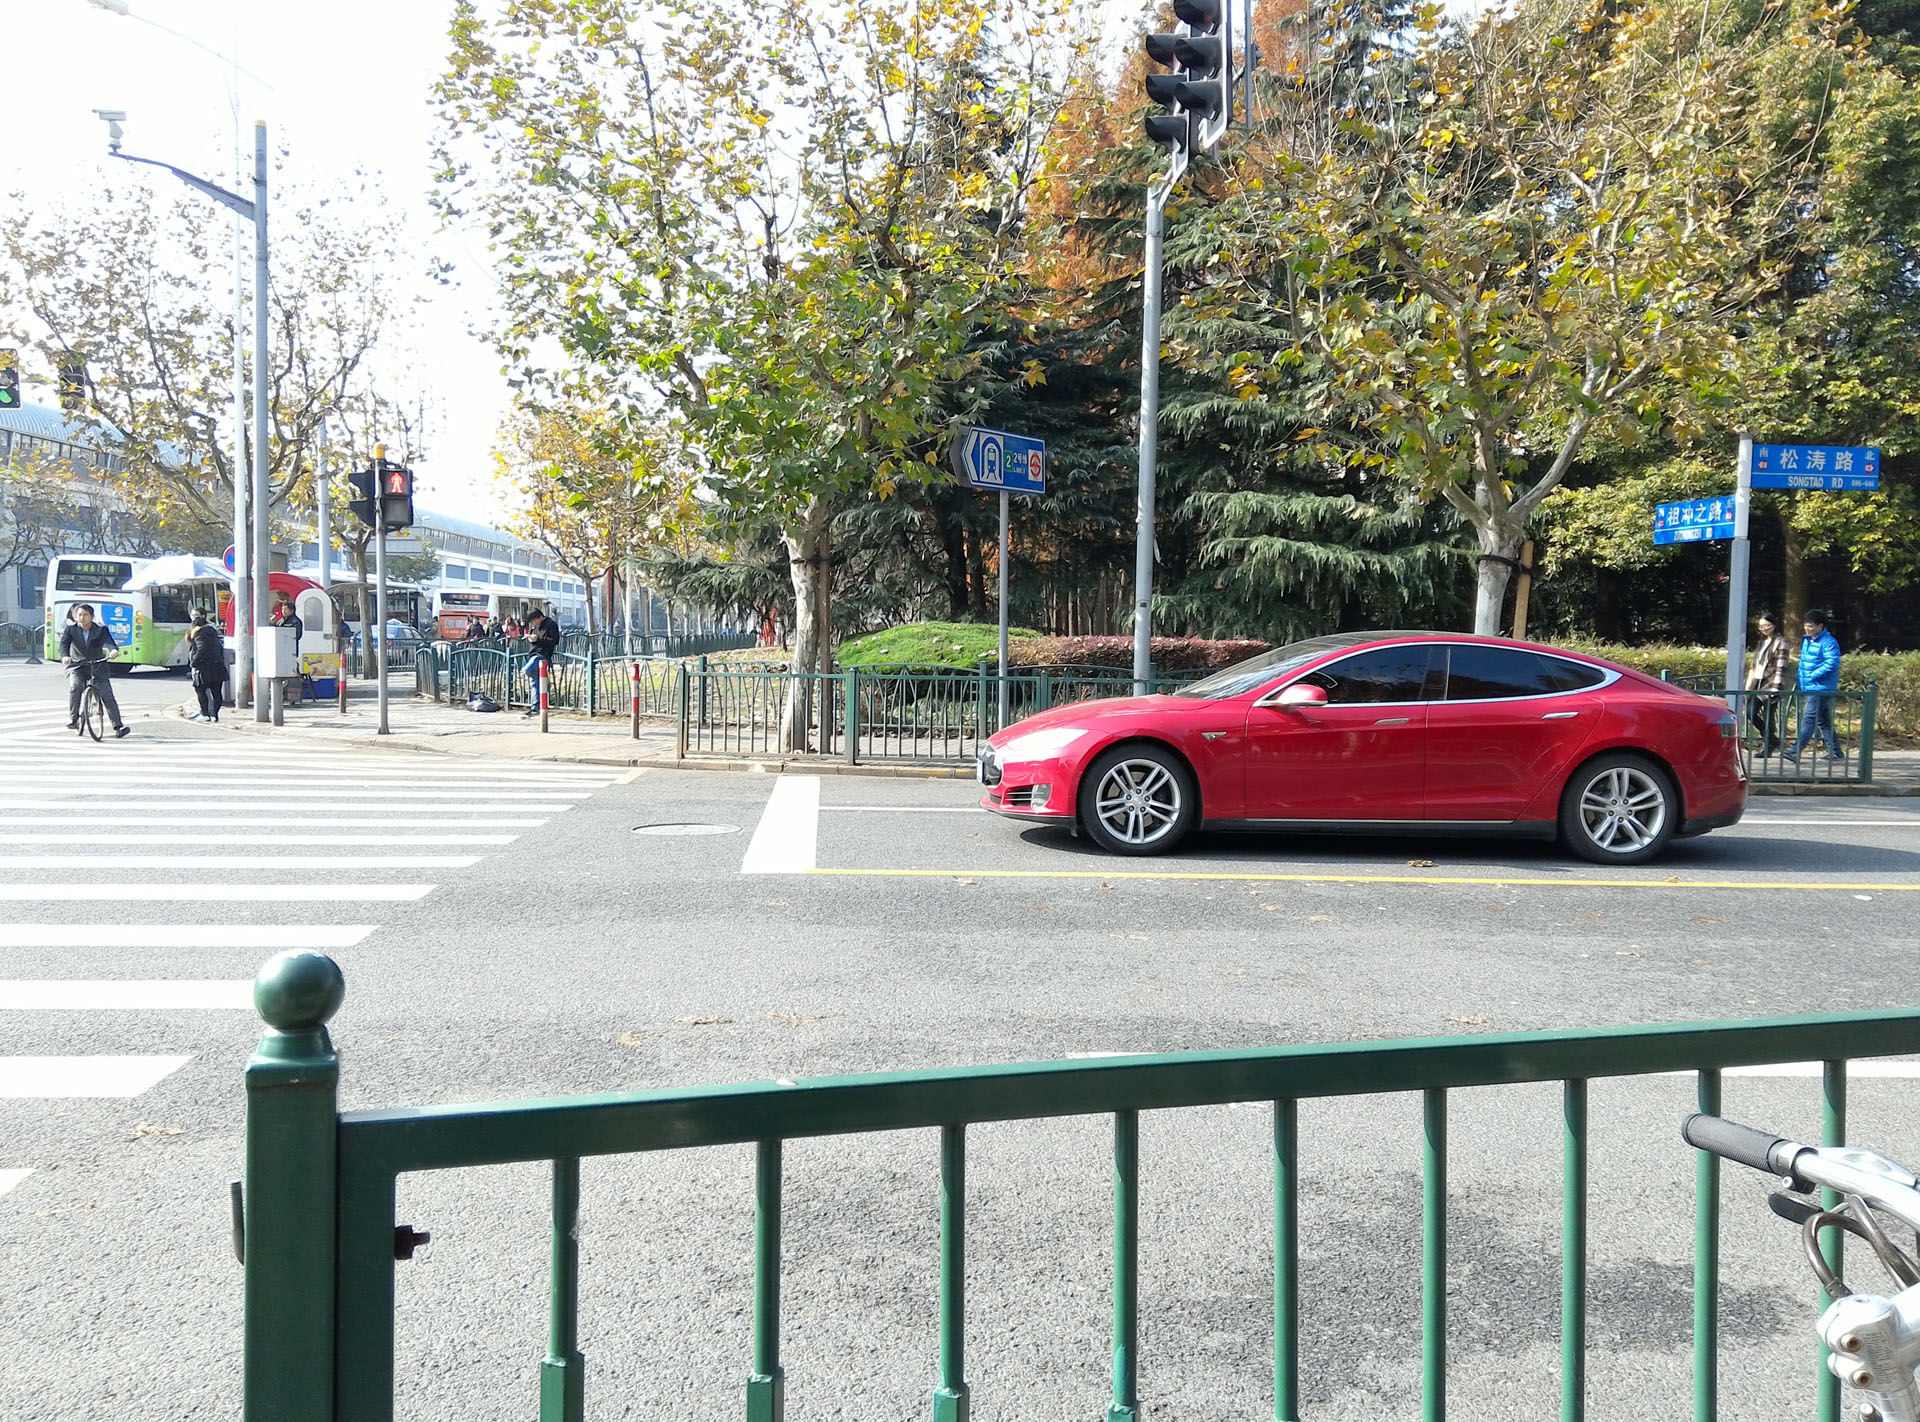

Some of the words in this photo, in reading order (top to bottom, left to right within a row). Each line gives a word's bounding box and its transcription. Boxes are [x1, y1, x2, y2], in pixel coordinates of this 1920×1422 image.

[1759, 447, 1769, 458] 南
[1865, 450, 1876, 461] 北
[1006, 455, 1011, 468] 2
[1780, 448, 1853, 472] 松涛路
[1788, 475, 1824, 488] SONGTAO
[1832, 477, 1844, 488] RD
[1667, 500, 1722, 526] 祖冲之路
